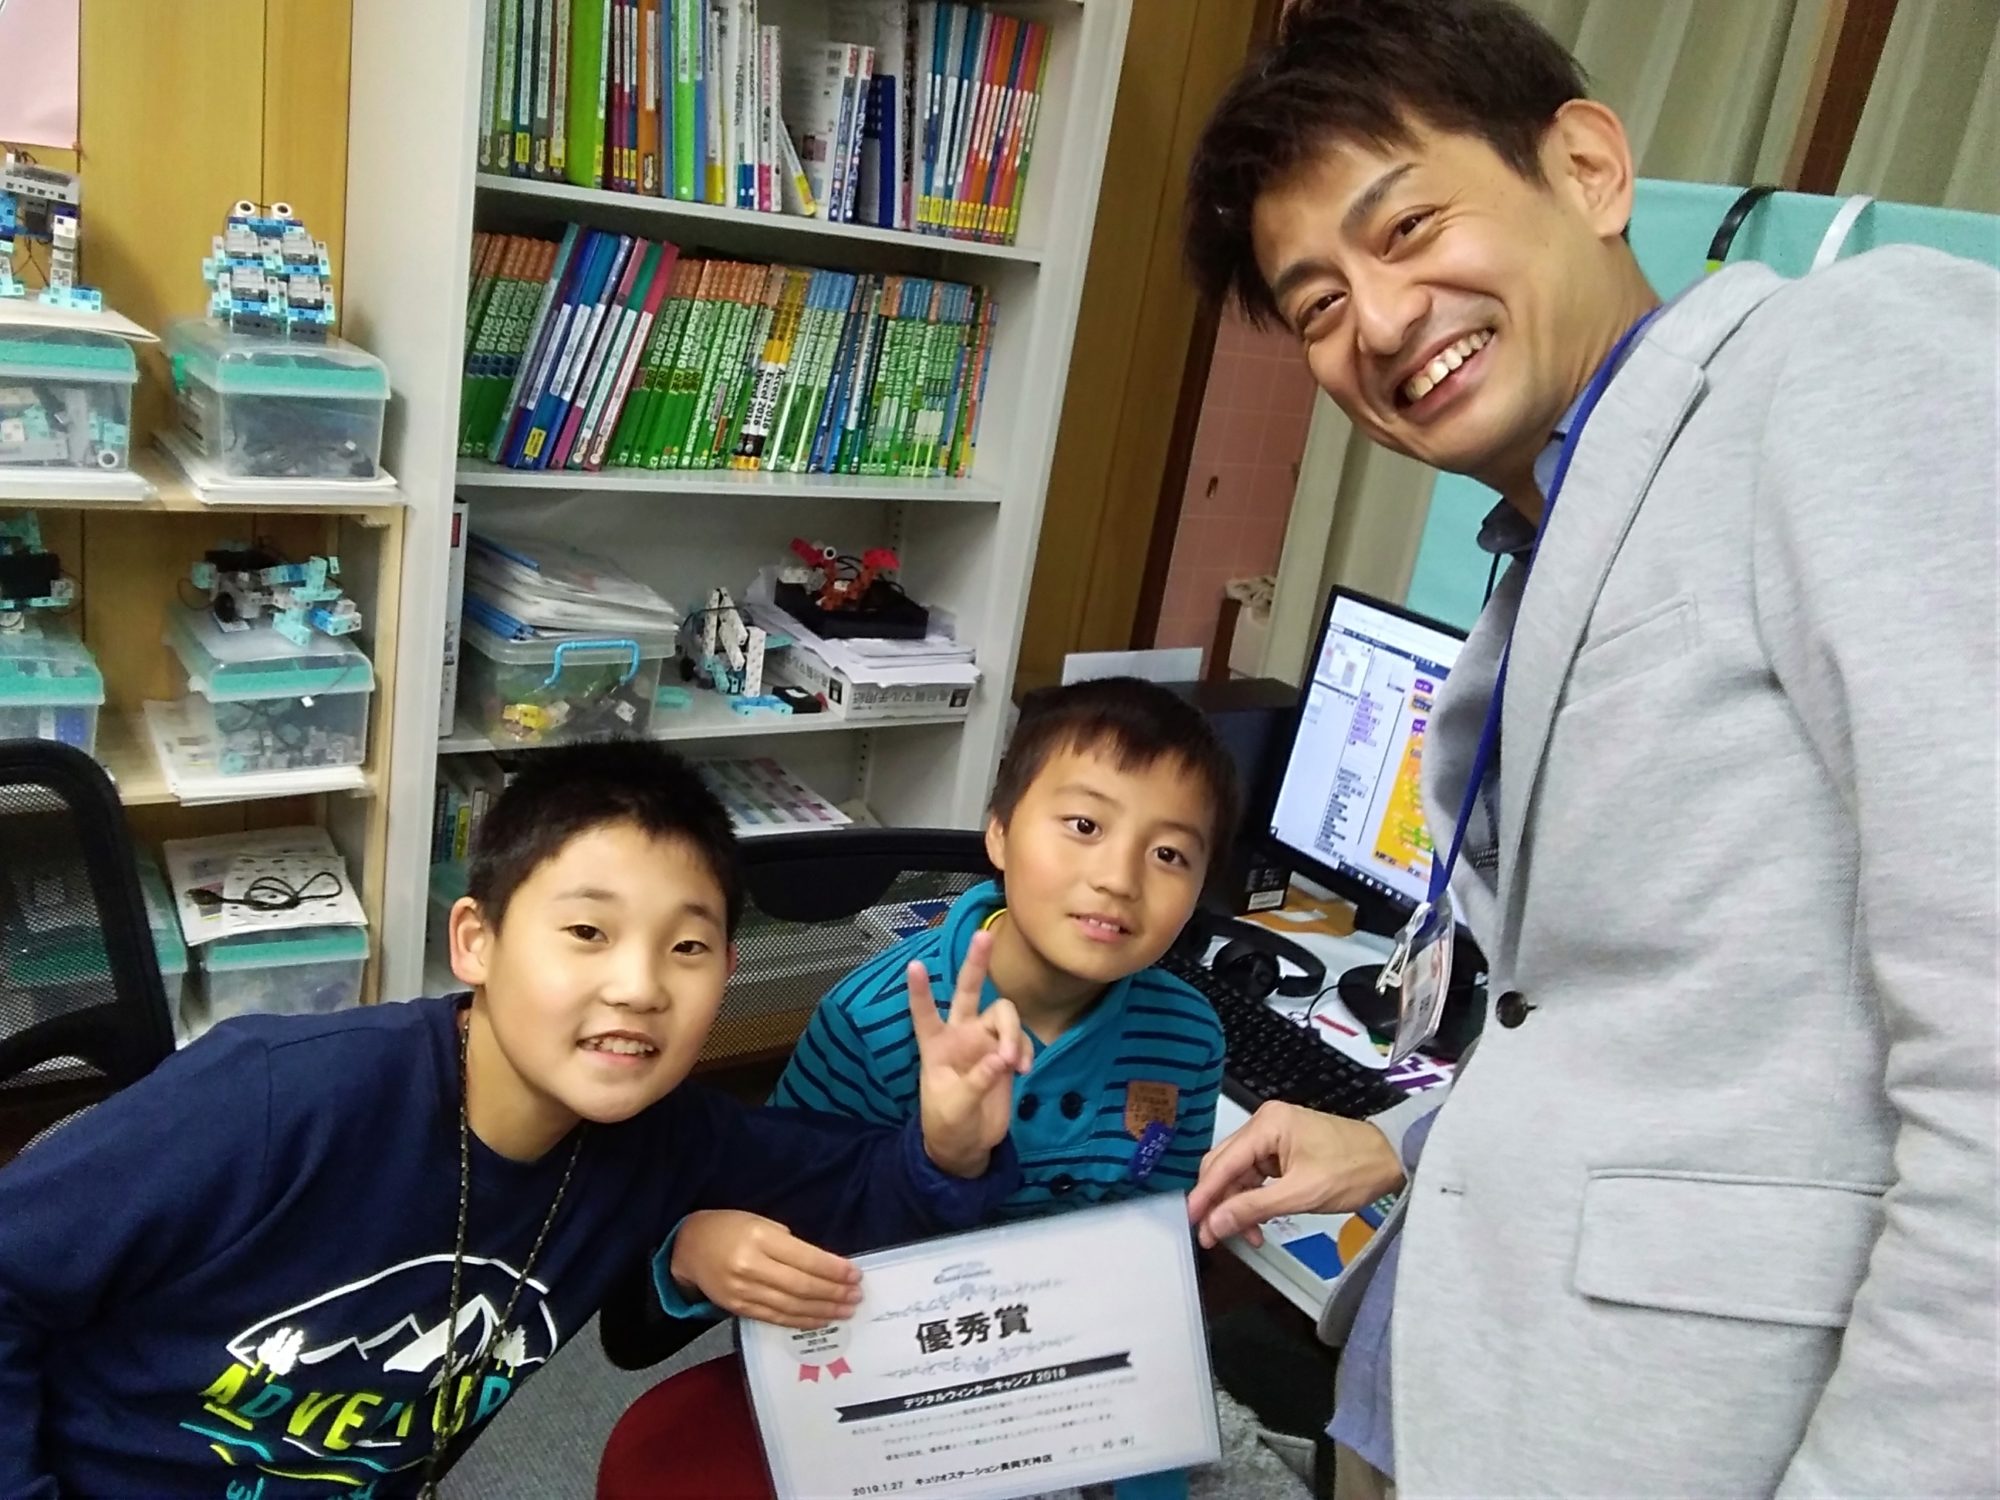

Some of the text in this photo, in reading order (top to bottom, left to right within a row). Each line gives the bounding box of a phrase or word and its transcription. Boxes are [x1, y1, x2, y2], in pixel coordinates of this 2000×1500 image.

[475, 278, 506, 351] Word 2016
[496, 279, 529, 353] Excel 2016
[661, 298, 689, 367] Excel 2016
[685, 299, 704, 336] Excel
[650, 332, 667, 365] 2016
[675, 335, 693, 369] 2016
[877, 319, 895, 382] Excel 2013
[743, 368, 763, 425] Word 2016
[753, 371, 773, 426] Excel 2016
[762, 367, 785, 430] Access 2016
[915, 1304, 1032, 1354] 優秀賞
[851, 1481, 904, 1497] 2019.1.27
